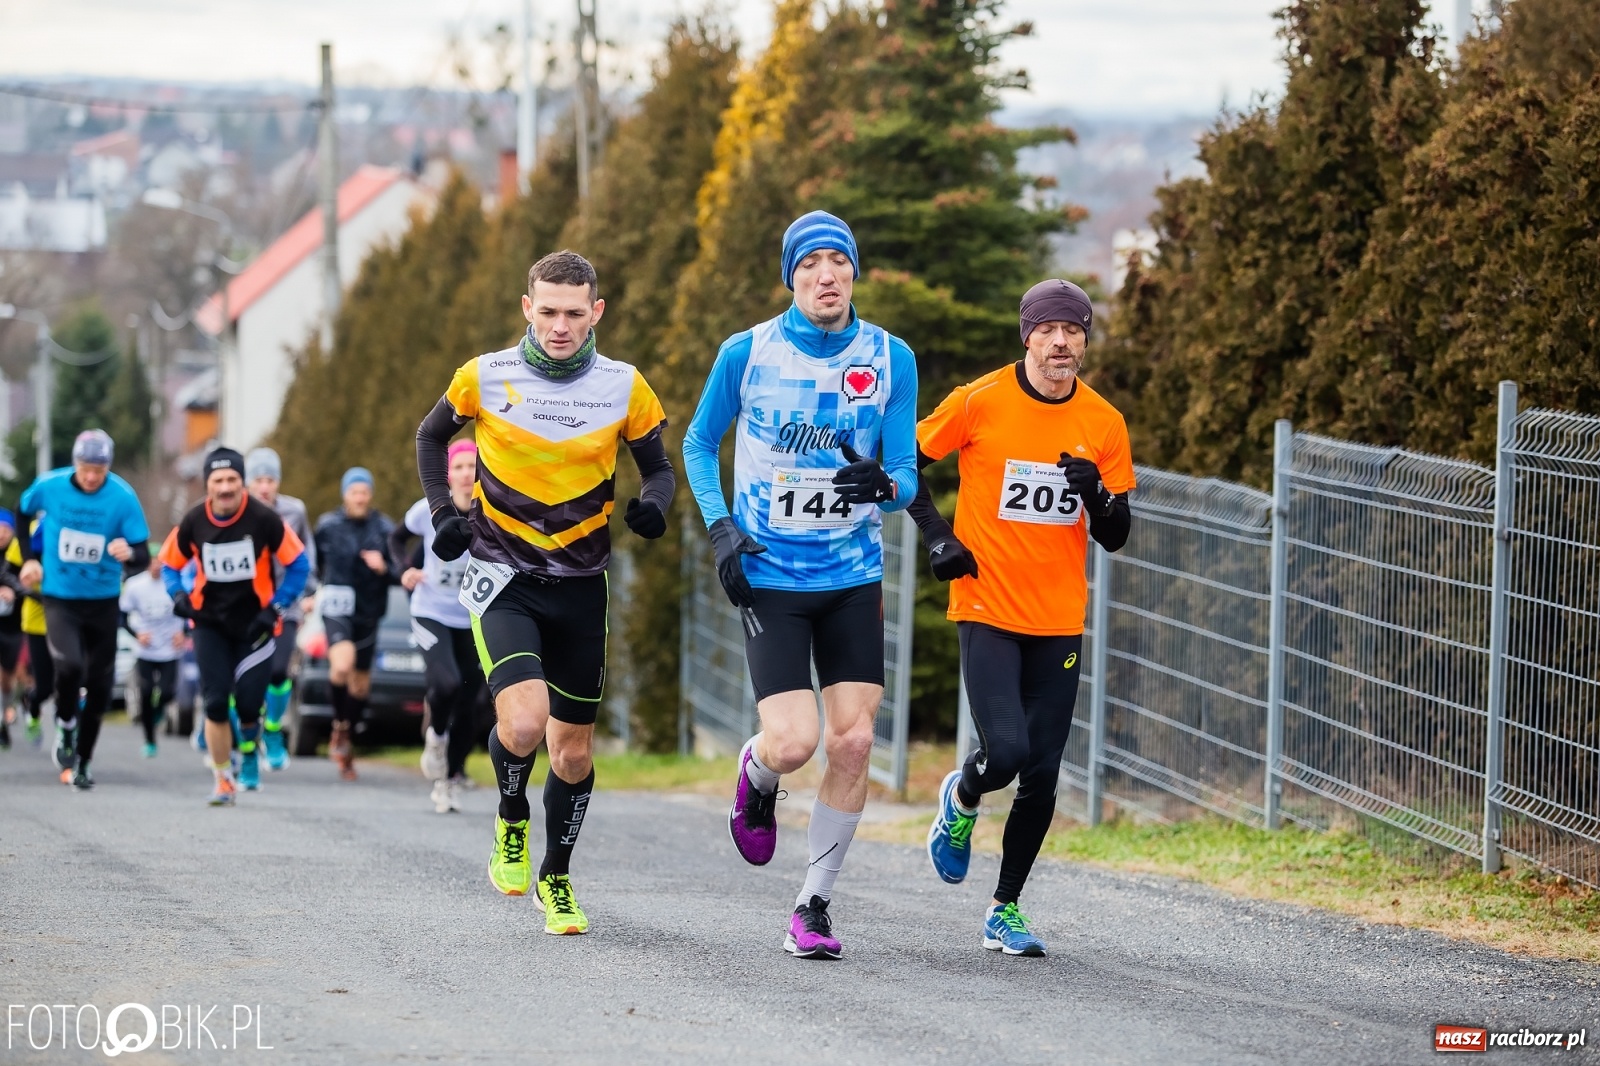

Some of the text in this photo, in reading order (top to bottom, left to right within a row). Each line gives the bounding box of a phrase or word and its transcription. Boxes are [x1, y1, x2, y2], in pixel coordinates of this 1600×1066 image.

[573, 400, 612, 409] biegania
[532, 412, 577, 423] saucony
[770, 440, 785, 454] dla
[778, 490, 852, 518] 144
[1005, 483, 1078, 514] 205
[63, 543, 98, 560] 166
[209, 556, 250, 574] 164
[462, 564, 494, 603] 59
